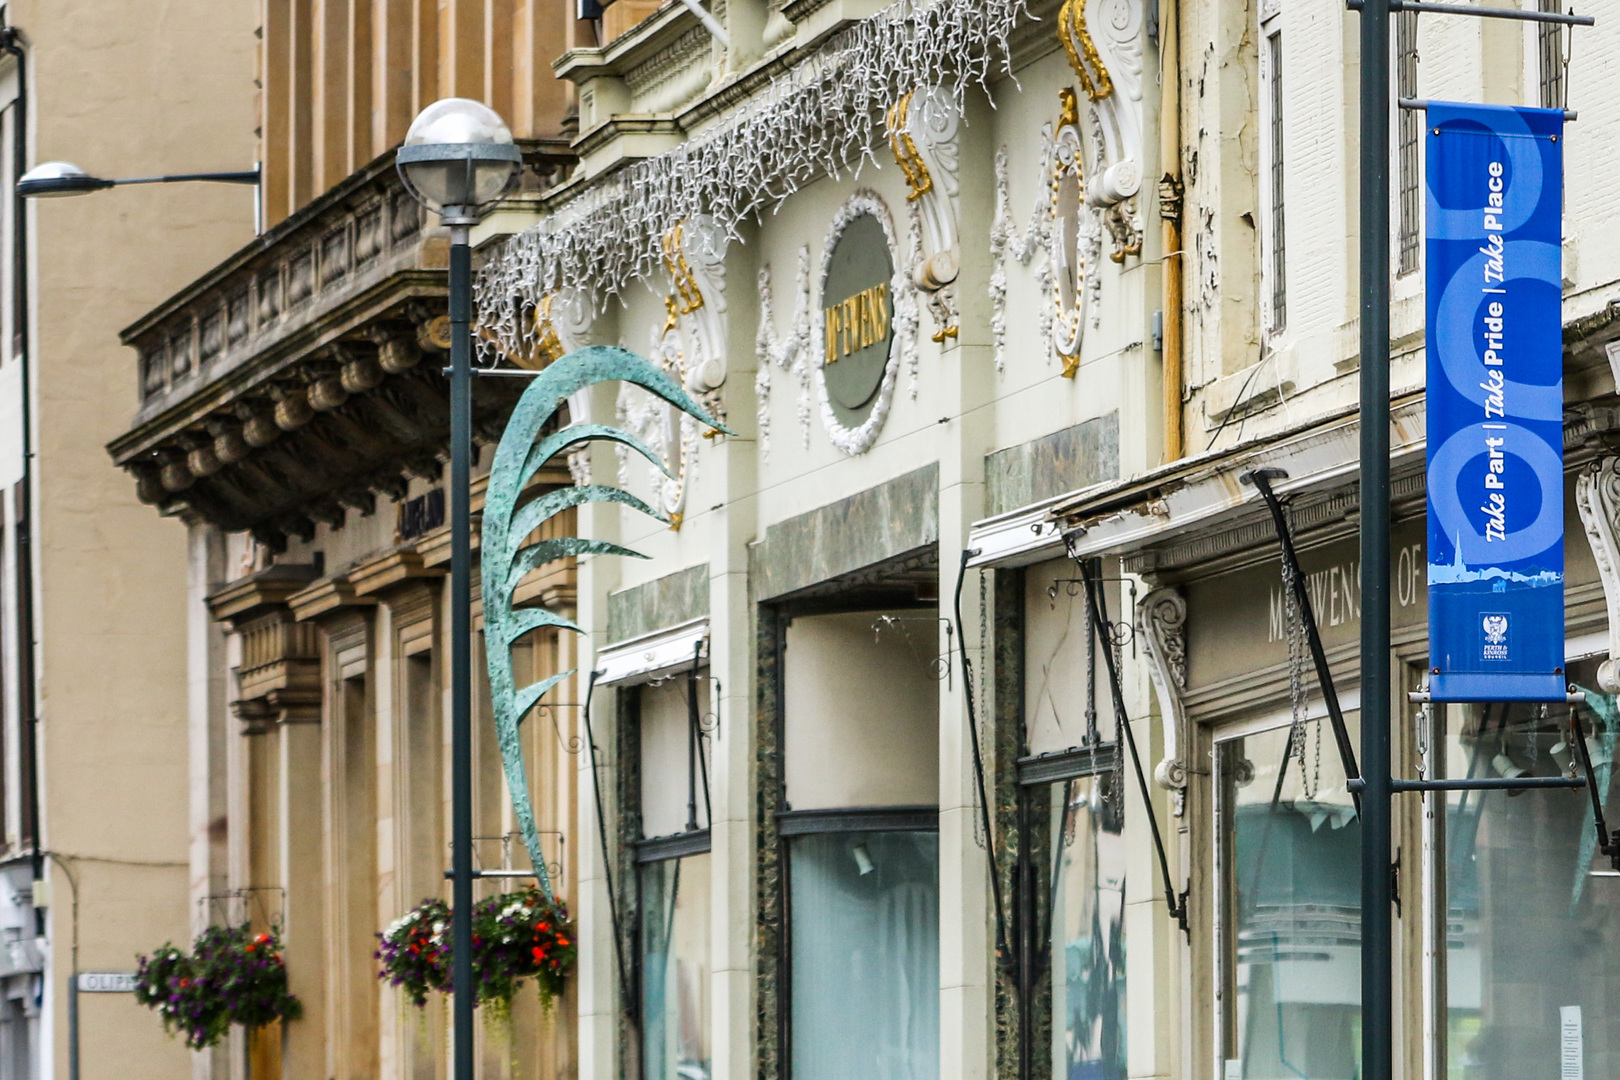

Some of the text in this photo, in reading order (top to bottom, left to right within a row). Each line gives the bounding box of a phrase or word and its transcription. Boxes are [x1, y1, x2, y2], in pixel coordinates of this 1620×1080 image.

[1479, 161, 1505, 542] Take Part Take Pride Take Place
[1398, 543, 1421, 607] OF
